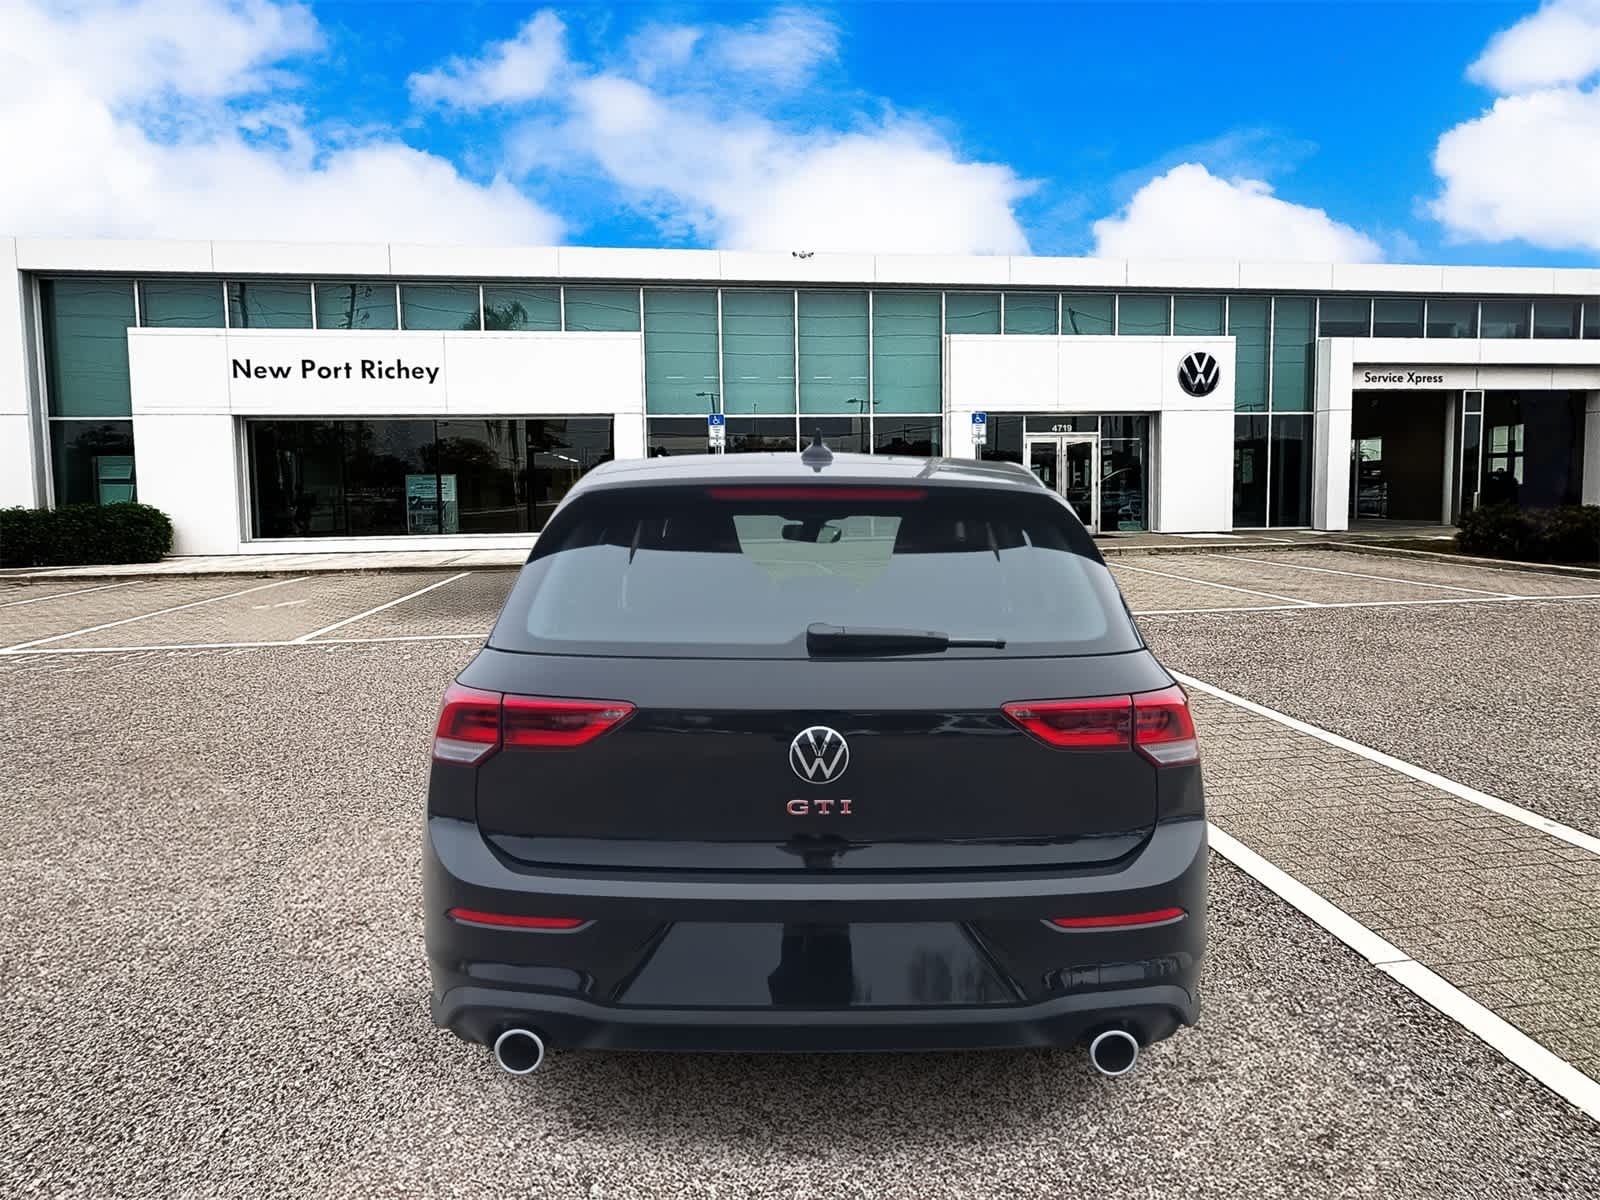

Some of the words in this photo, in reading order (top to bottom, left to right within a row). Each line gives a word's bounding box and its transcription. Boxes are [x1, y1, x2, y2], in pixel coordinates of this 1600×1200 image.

[232, 359, 292, 379] New
[301, 359, 352, 379] Port
[361, 359, 440, 384] Richey
[1364, 371, 1404, 383] Service
[1407, 372, 1444, 385] Xpress
[1051, 424, 1073, 432] 4719
[786, 799, 852, 815] GTI
